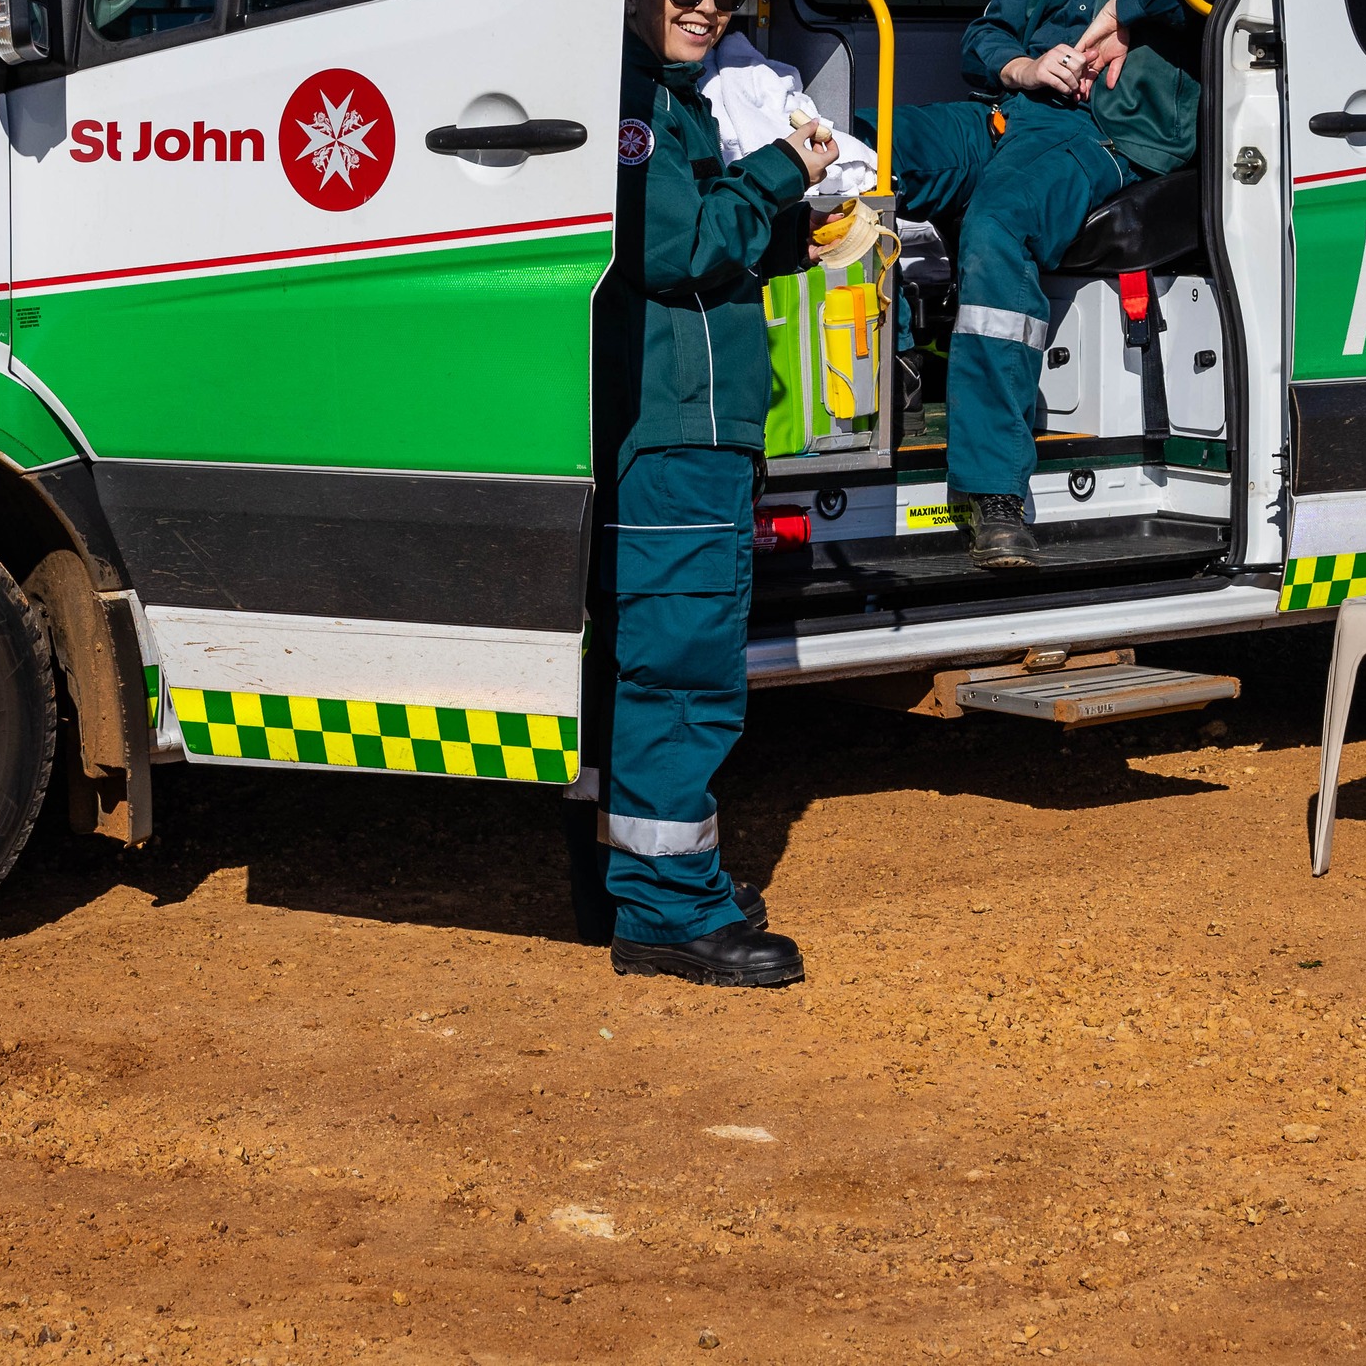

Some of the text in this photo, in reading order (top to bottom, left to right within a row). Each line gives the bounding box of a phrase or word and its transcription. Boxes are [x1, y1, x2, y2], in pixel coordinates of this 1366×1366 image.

[69, 119, 265, 163] St John
[1191, 288, 1199, 303] 9
[909, 503, 973, 517] MAXIMUM WEI
[932, 514, 965, 525] 200KGS
